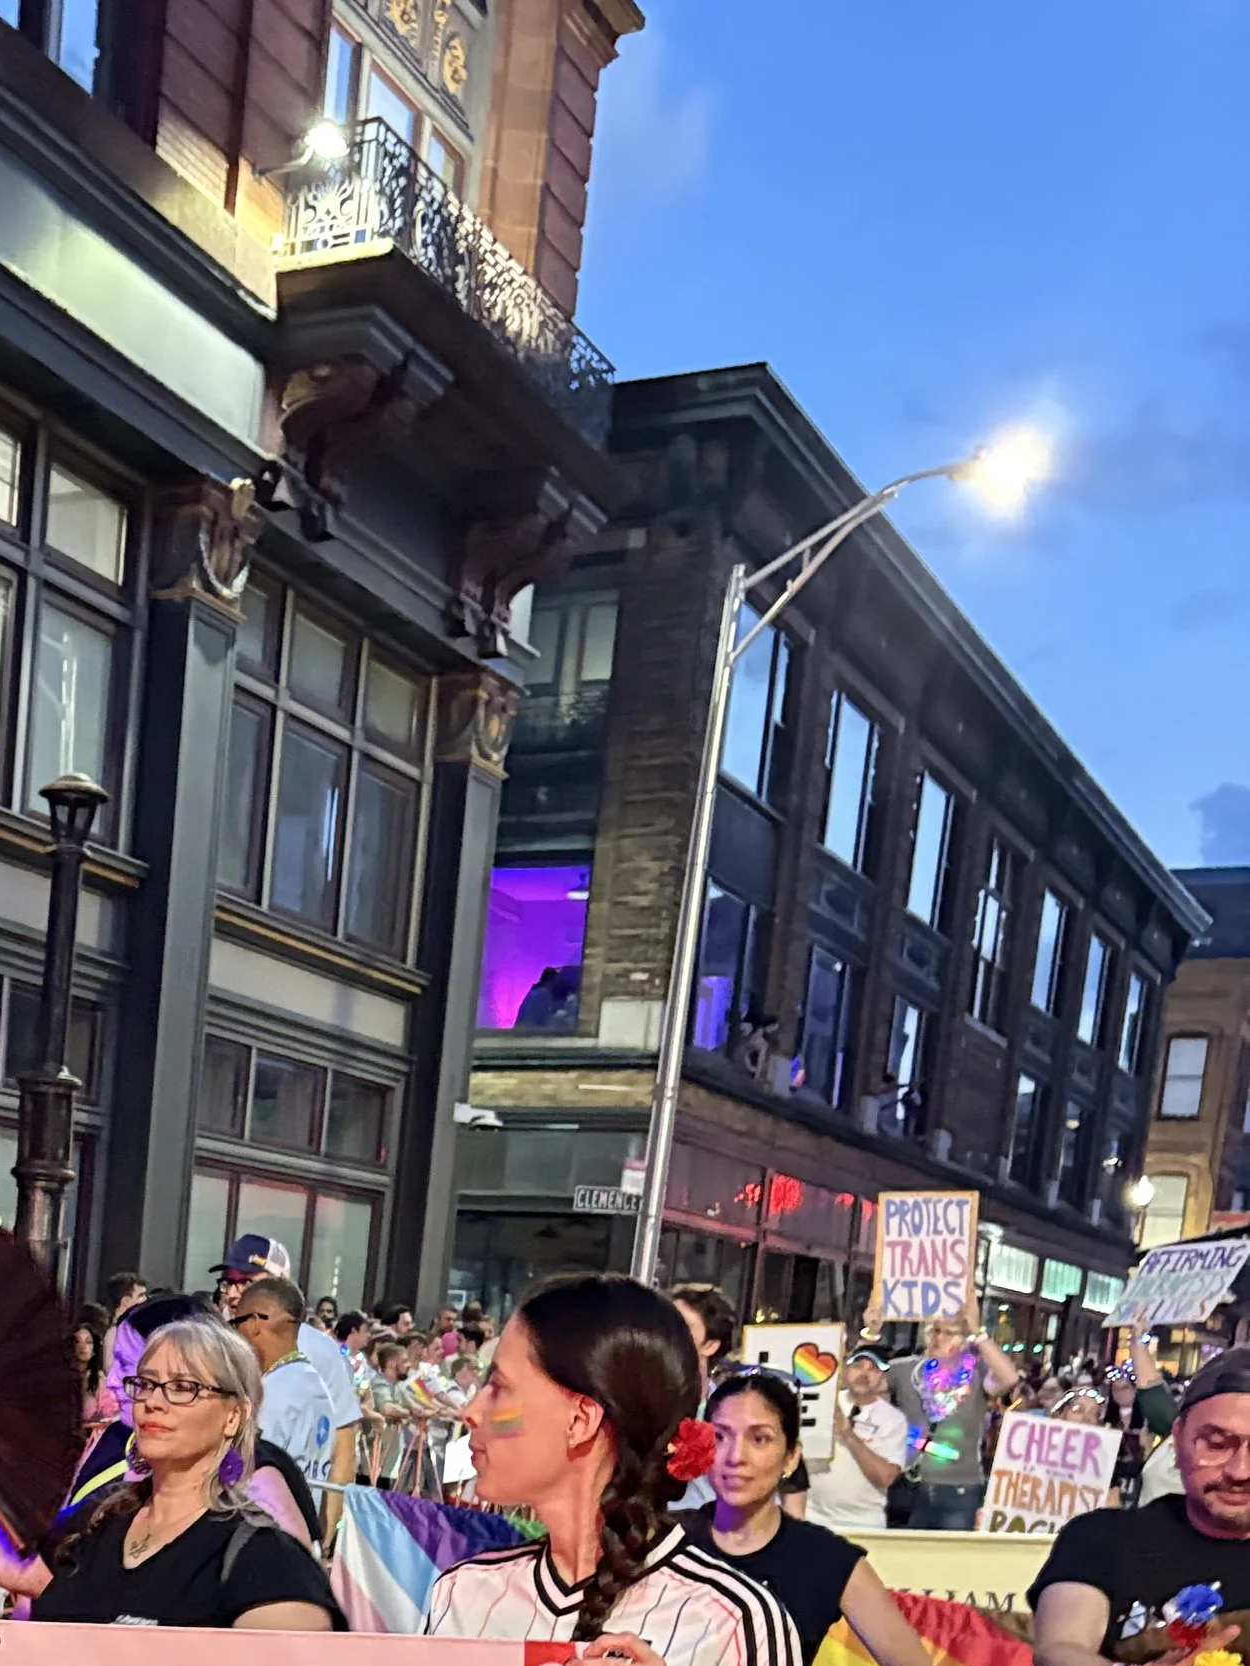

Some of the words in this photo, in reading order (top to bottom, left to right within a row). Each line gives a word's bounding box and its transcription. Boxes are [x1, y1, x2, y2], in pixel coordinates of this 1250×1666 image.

[577, 1189, 638, 1211] CLEMENCE
[885, 1198, 970, 1238] PROTECT
[885, 1238, 968, 1280] TRANS
[881, 1279, 967, 1320] KIDS
[1005, 1419, 1103, 1478] CHEER
